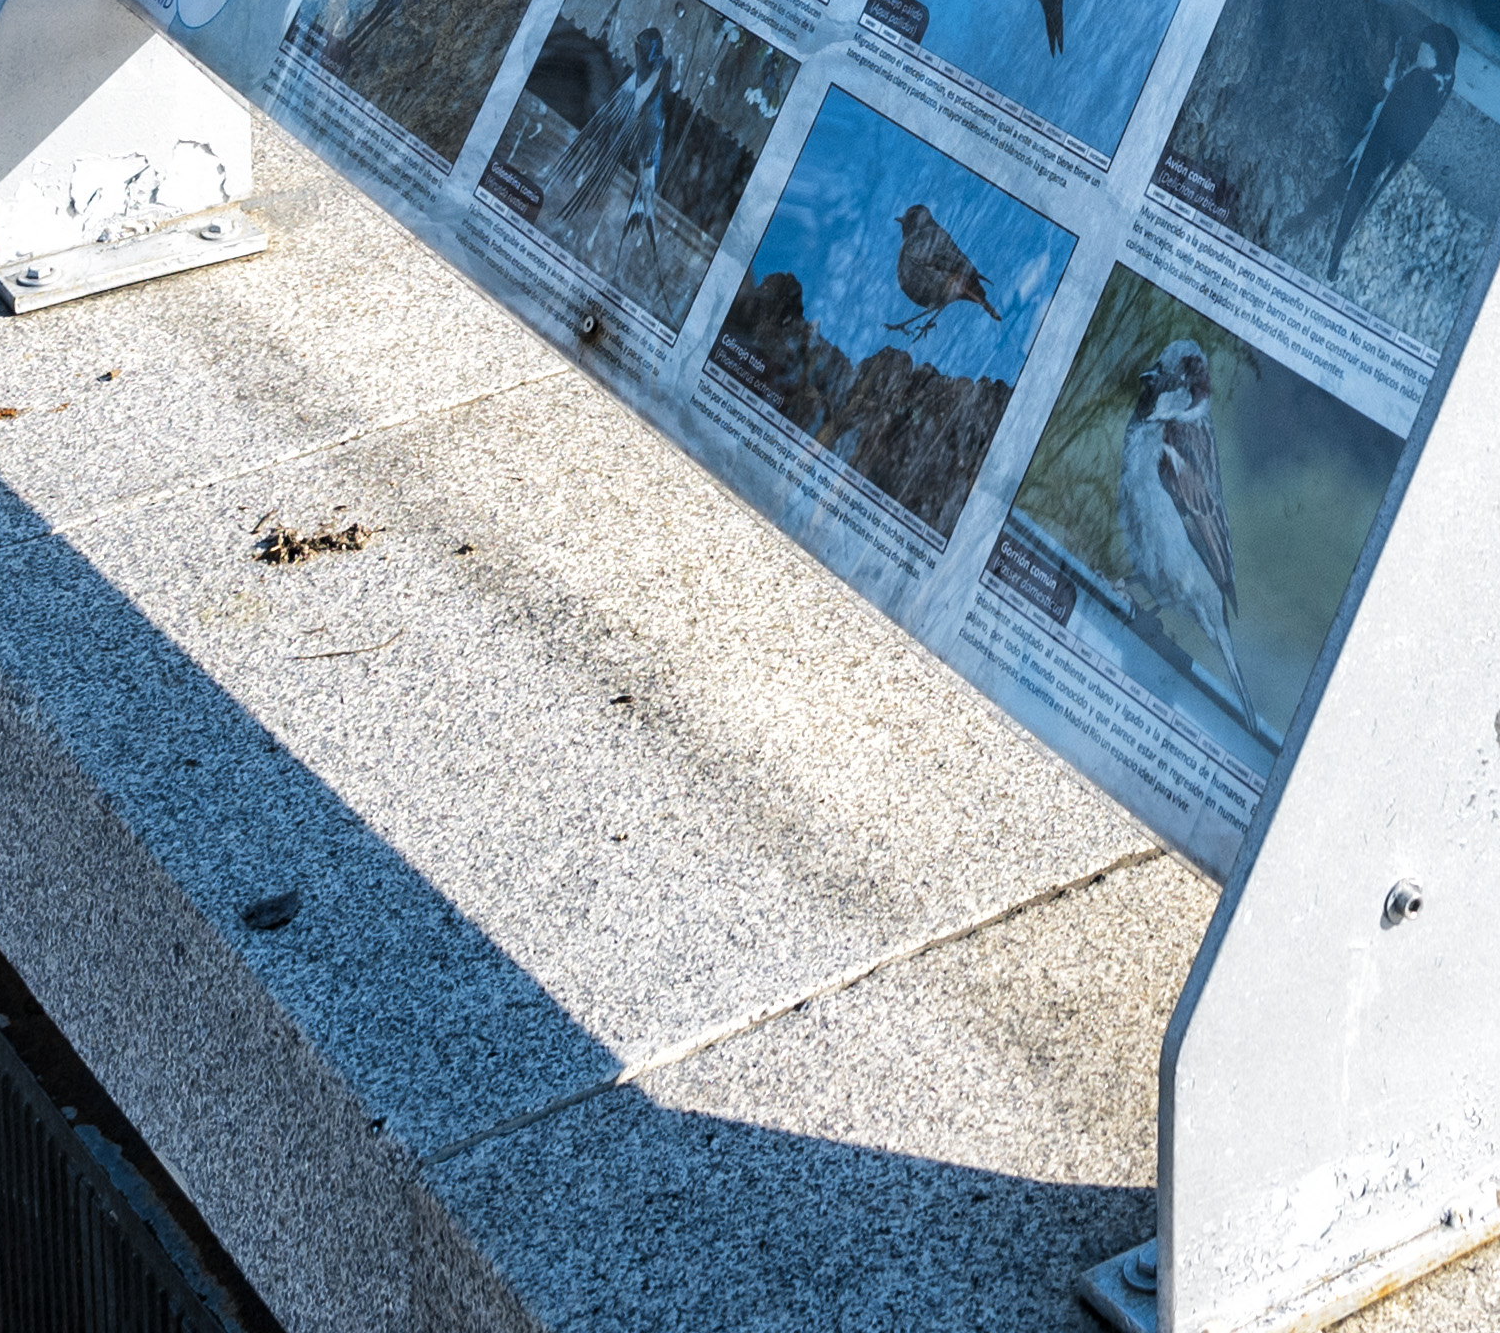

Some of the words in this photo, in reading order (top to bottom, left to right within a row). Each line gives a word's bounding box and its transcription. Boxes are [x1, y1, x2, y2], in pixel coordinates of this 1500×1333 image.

[900, 1, 924, 24] pálido
[520, 181, 541, 203] común
[1157, 169, 1196, 202] (Delichon
[1193, 190, 1231, 222] urbicum)
[1164, 153, 1190, 176] Avión
[1187, 166, 1217, 192] común
[1131, 220, 1144, 235] los
[1174, 246, 1195, 266] suele
[1192, 260, 1222, 284] posarse
[1220, 276, 1238, 294] para
[1236, 287, 1266, 311] recoger
[1265, 301, 1288, 322] barro
[1286, 316, 1301, 331] con
[1300, 322, 1311, 336] el
[1308, 330, 1325, 347] que
[1324, 337, 1360, 366] construir
[1358, 360, 1373, 375] sus
[1371, 366, 1400, 393] típicos
[1398, 382, 1422, 404] nidos
[1137, 204, 1156, 224] Muy
[1153, 214, 1186, 242] parecido
[1190, 235, 1199, 248] la
[1236, 265, 1256, 284] pero
[1254, 274, 1273, 292] más
[1269, 283, 1305, 313] pequeño
[1348, 330, 1363, 346] No
[1361, 340, 1377, 355] son
[1375, 346, 1391, 363] tan
[1389, 354, 1418, 379] aéreos
[719, 332, 751, 364] Colirrojo
[748, 352, 767, 373] tizón
[991, 555, 1022, 587] (Passer
[1018, 575, 1067, 621] domesticus)
[1000, 538, 1032, 569] Gorrión
[1029, 559, 1059, 589] común
[973, 590, 1012, 627] Totalmente
[1009, 619, 1046, 654] adaptado
[1043, 644, 1054, 659] al
[1052, 651, 1088, 685] ambiente
[1086, 677, 1115, 706] urbano
[1119, 703, 1146, 732] ligado
[1151, 727, 1162, 742] la
[1159, 734, 1199, 773] presencia
[1197, 762, 1211, 780] de
[988, 628, 1004, 646] por
[1002, 636, 1022, 658] todo
[1020, 649, 1031, 664] el
[1028, 656, 1057, 685] mundo
[1054, 676, 1089, 710] conocido
[1093, 709, 1110, 729] que
[1108, 721, 1136, 750] parece
[1135, 739, 1158, 764] estar
[1156, 757, 1168, 772] en
[1166, 764, 1205, 803] regresión
[1203, 794, 1216, 810] en
[1215, 804, 1248, 835] numero
